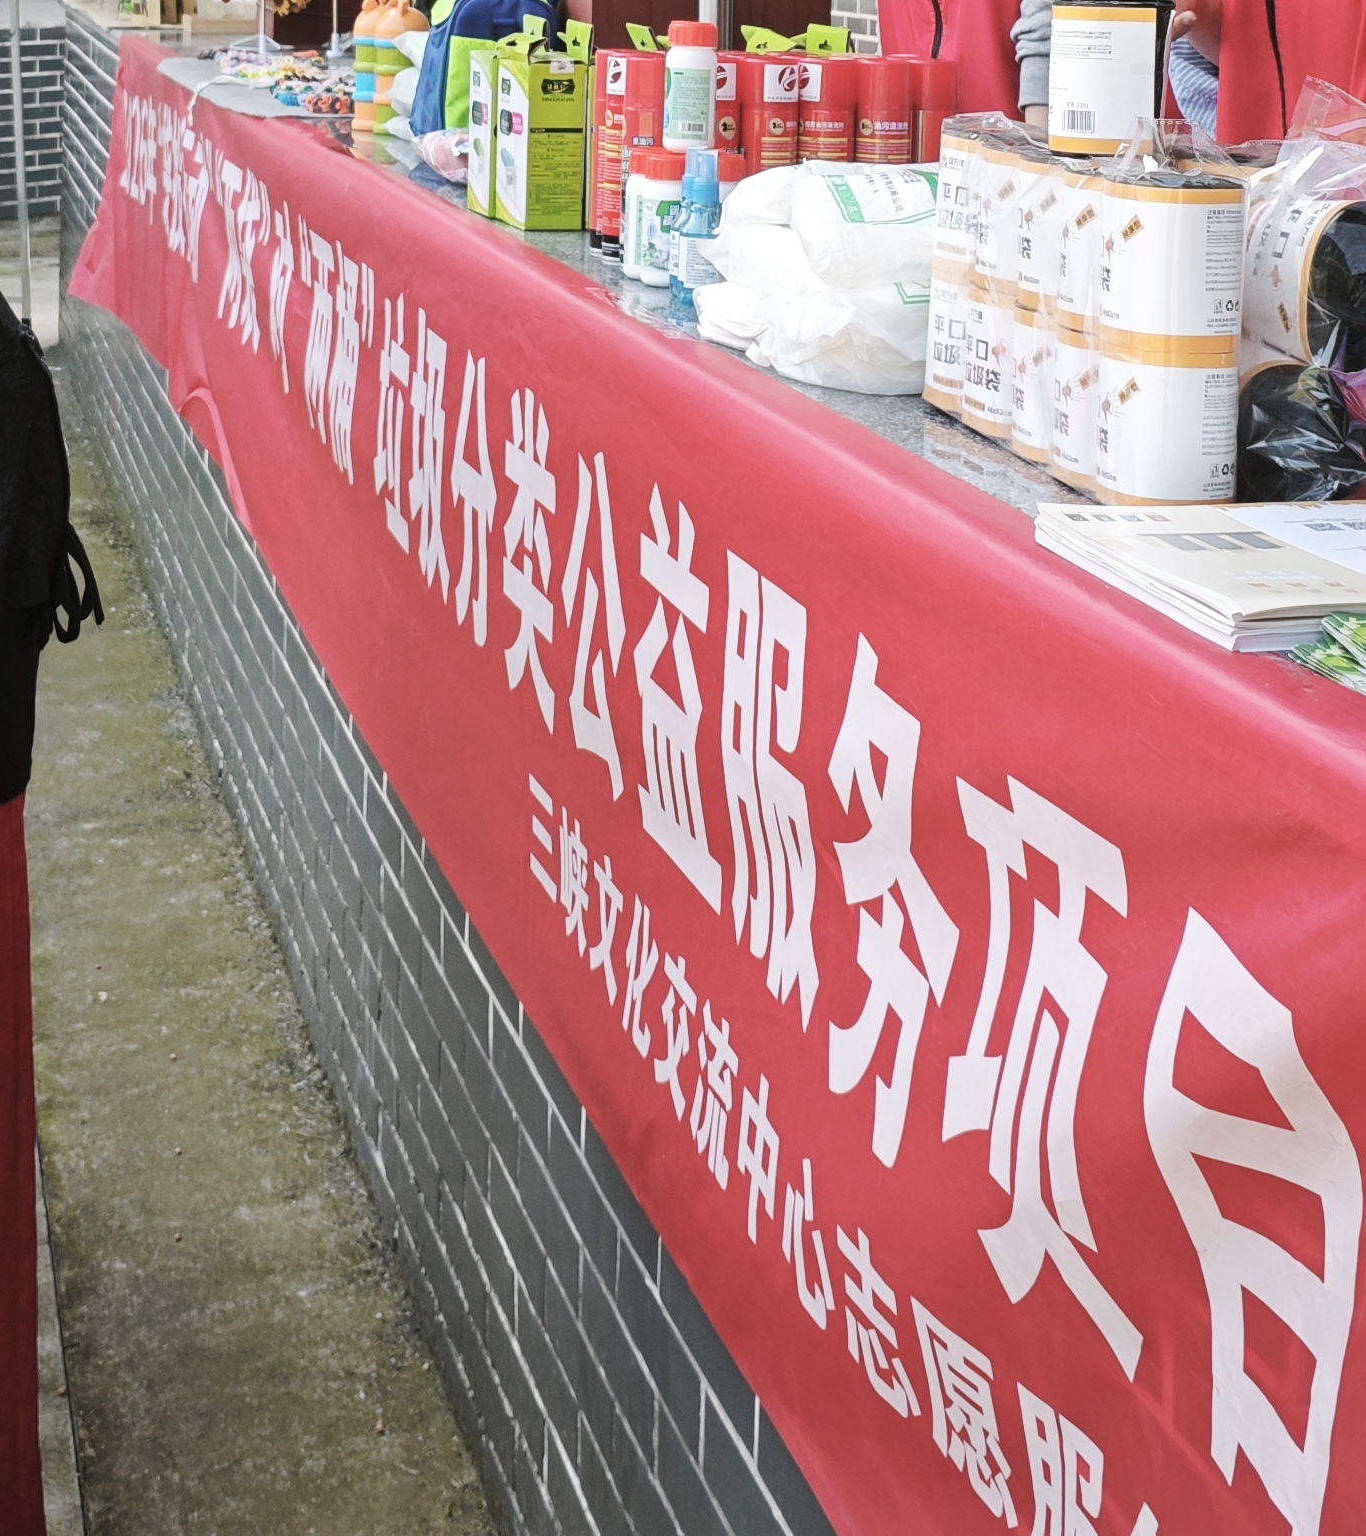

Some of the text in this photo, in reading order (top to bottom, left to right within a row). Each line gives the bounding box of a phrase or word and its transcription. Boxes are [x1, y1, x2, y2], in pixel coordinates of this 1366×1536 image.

[528, 774, 1161, 1536] 三峡文化交流中心志愿服
